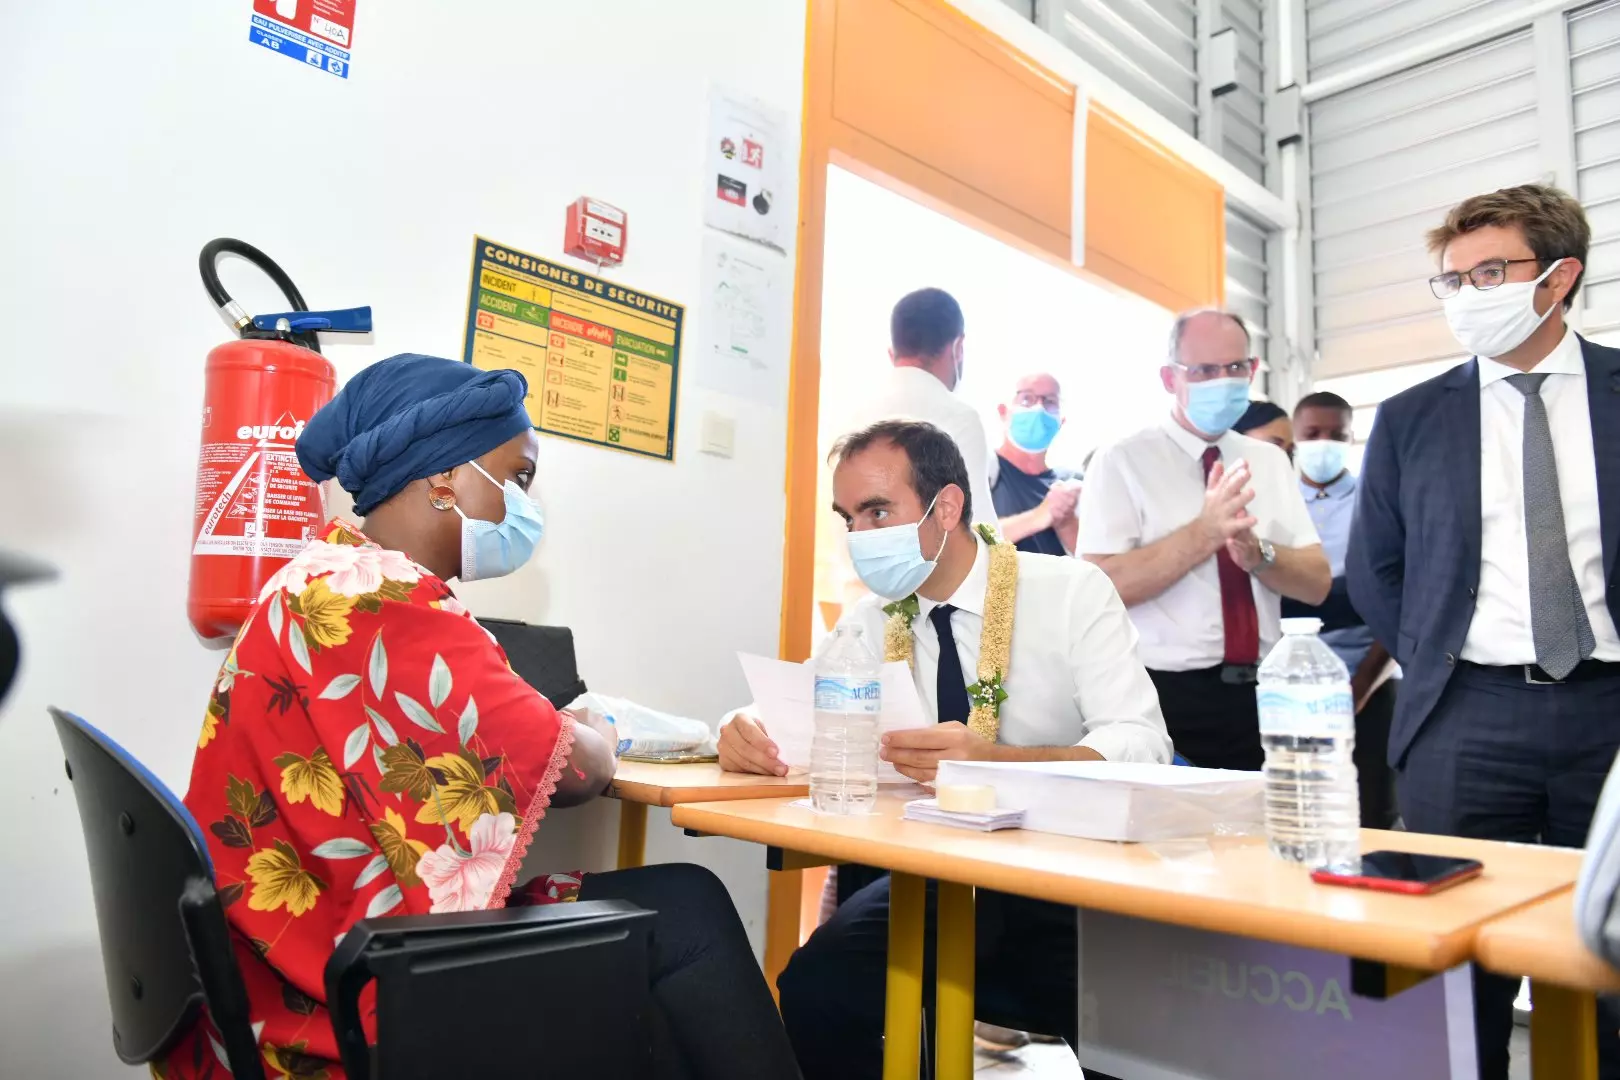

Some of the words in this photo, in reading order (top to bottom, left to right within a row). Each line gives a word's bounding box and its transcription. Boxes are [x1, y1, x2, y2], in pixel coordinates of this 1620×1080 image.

[307, 36, 325, 50] AVEC
[482, 274, 517, 293] INCIDENT
[484, 245, 579, 286] CONSIGNES
[584, 277, 603, 294] DE
[608, 285, 679, 319] SECURITE
[480, 294, 518, 314] ACCIDENT
[273, 499, 300, 507] COMMANDE
[204, 491, 232, 535] eurotech
